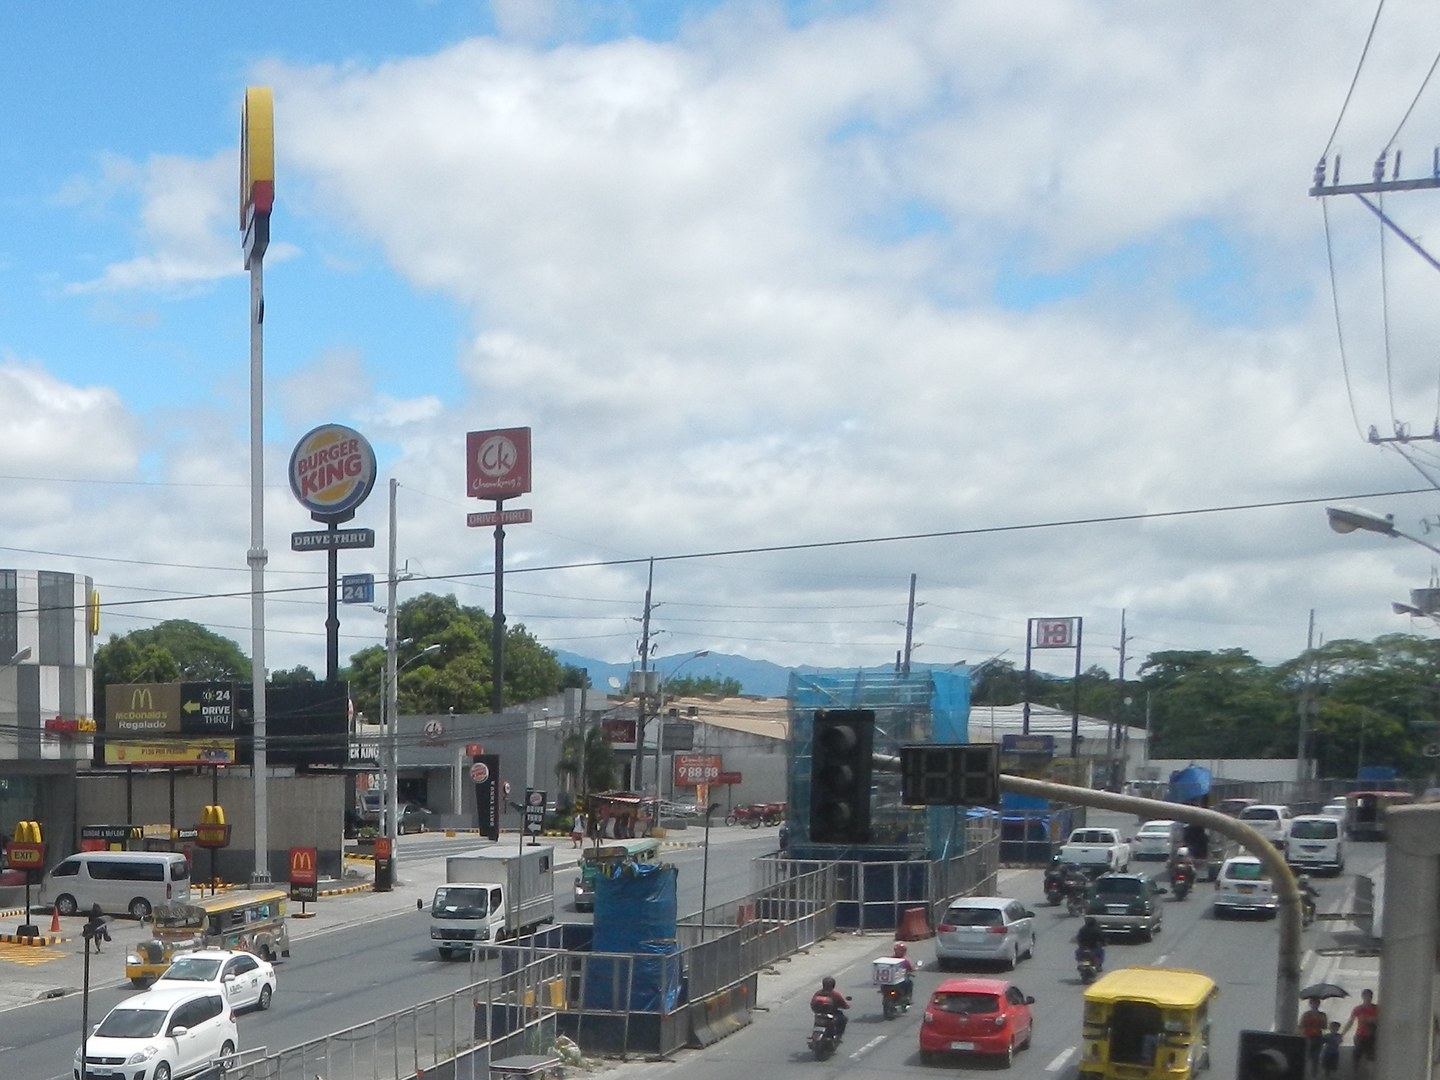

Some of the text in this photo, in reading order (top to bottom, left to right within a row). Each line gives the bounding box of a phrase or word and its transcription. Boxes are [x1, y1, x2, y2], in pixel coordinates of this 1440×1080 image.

[298, 439, 359, 477] BURGER
[300, 455, 362, 499] KING
[469, 510, 525, 525] DRIVE THRU
[293, 532, 367, 547] DRIVE THRU
[343, 586, 365, 600] 24
[215, 690, 231, 701] 24
[201, 705, 230, 715] DRIVE
[115, 711, 167, 721] McDonald's
[204, 715, 229, 725] THRU
[118, 719, 167, 730] Regalado
[361, 743, 379, 759] KING
[526, 805, 544, 814] DRIVE
[14, 851, 34, 860] EXIT
